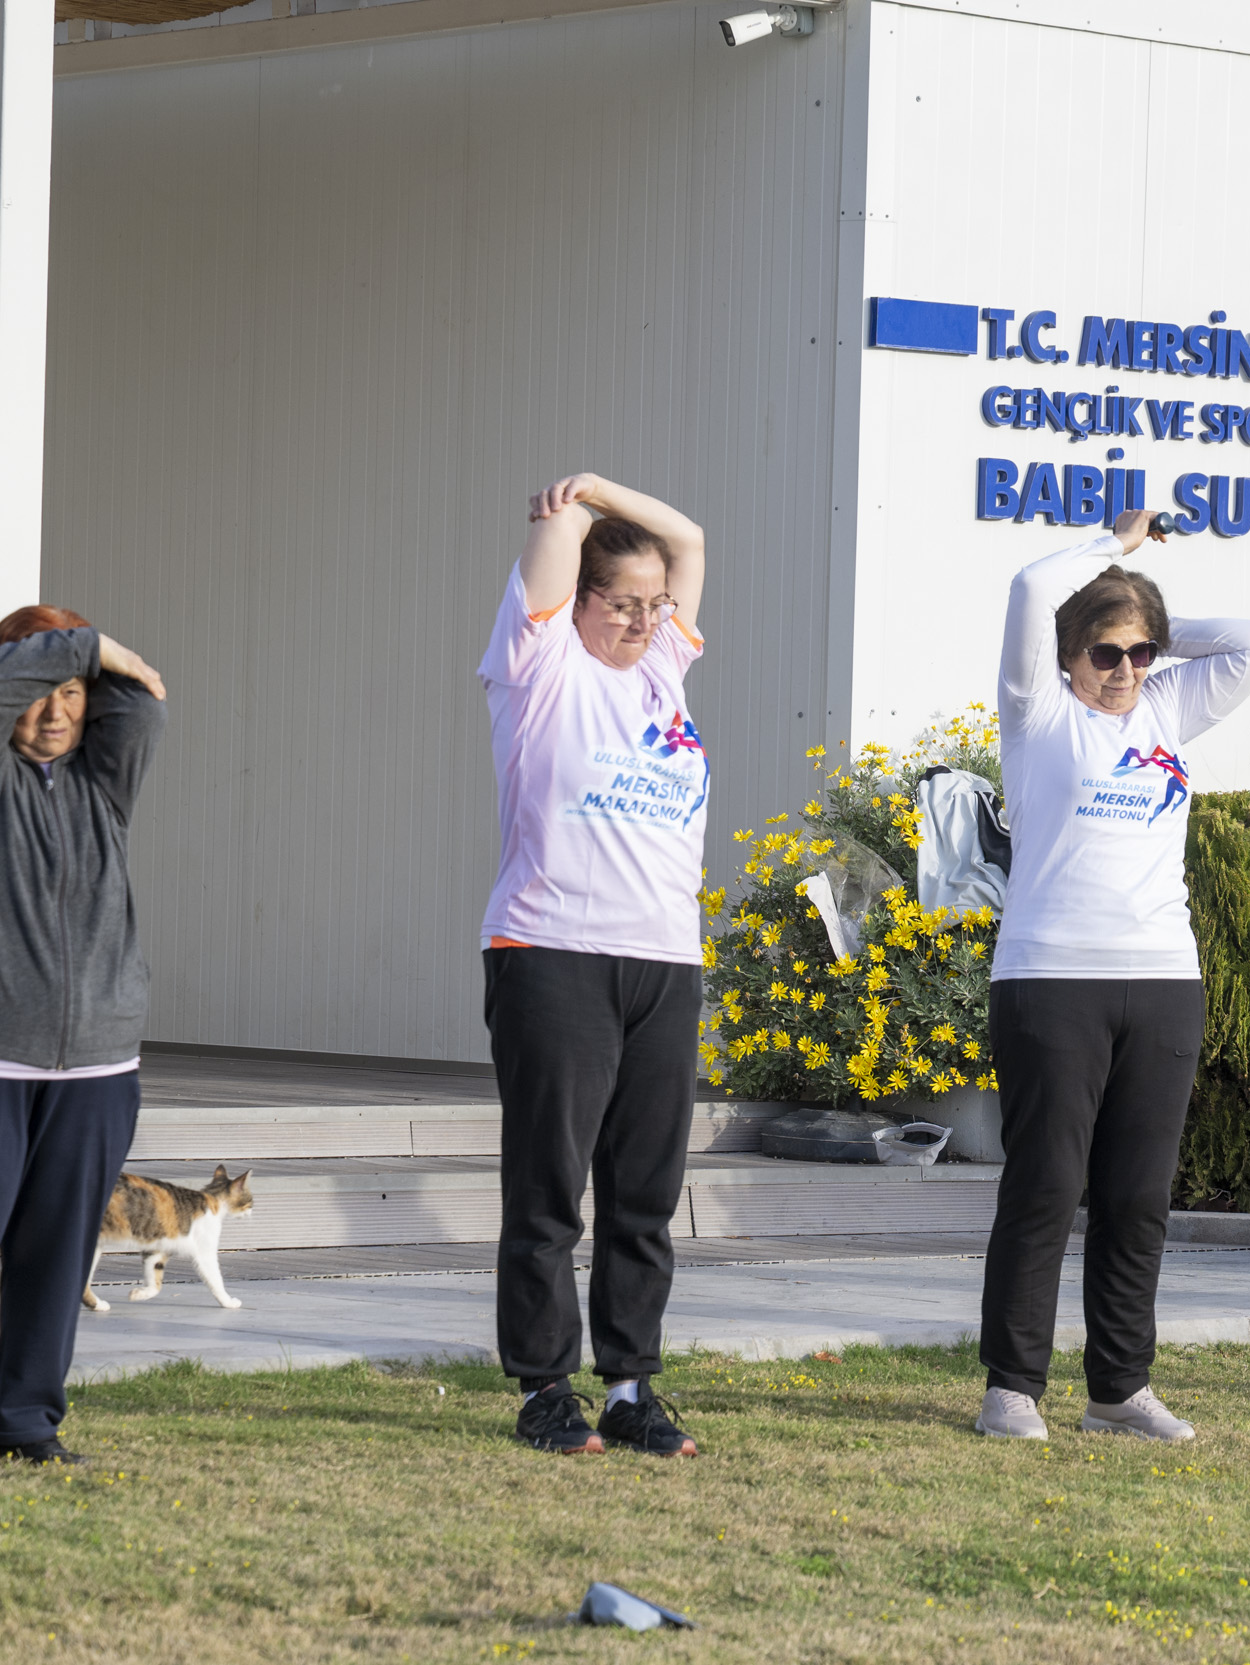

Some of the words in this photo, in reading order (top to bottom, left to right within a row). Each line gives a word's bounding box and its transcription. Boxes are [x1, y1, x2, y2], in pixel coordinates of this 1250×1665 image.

[981, 307, 1070, 364] T.C.
[981, 385, 1145, 442] GENÇLİK
[1146, 399, 1195, 441] VE
[594, 752, 697, 782] ULUSLARARASI
[611, 773, 690, 803] MERSİN
[1081, 778, 1156, 794] ULUSLARARASI
[1093, 791, 1152, 808] MERSİN
[582, 792, 683, 821] MARATONU
[1075, 805, 1146, 821] MARATONU
